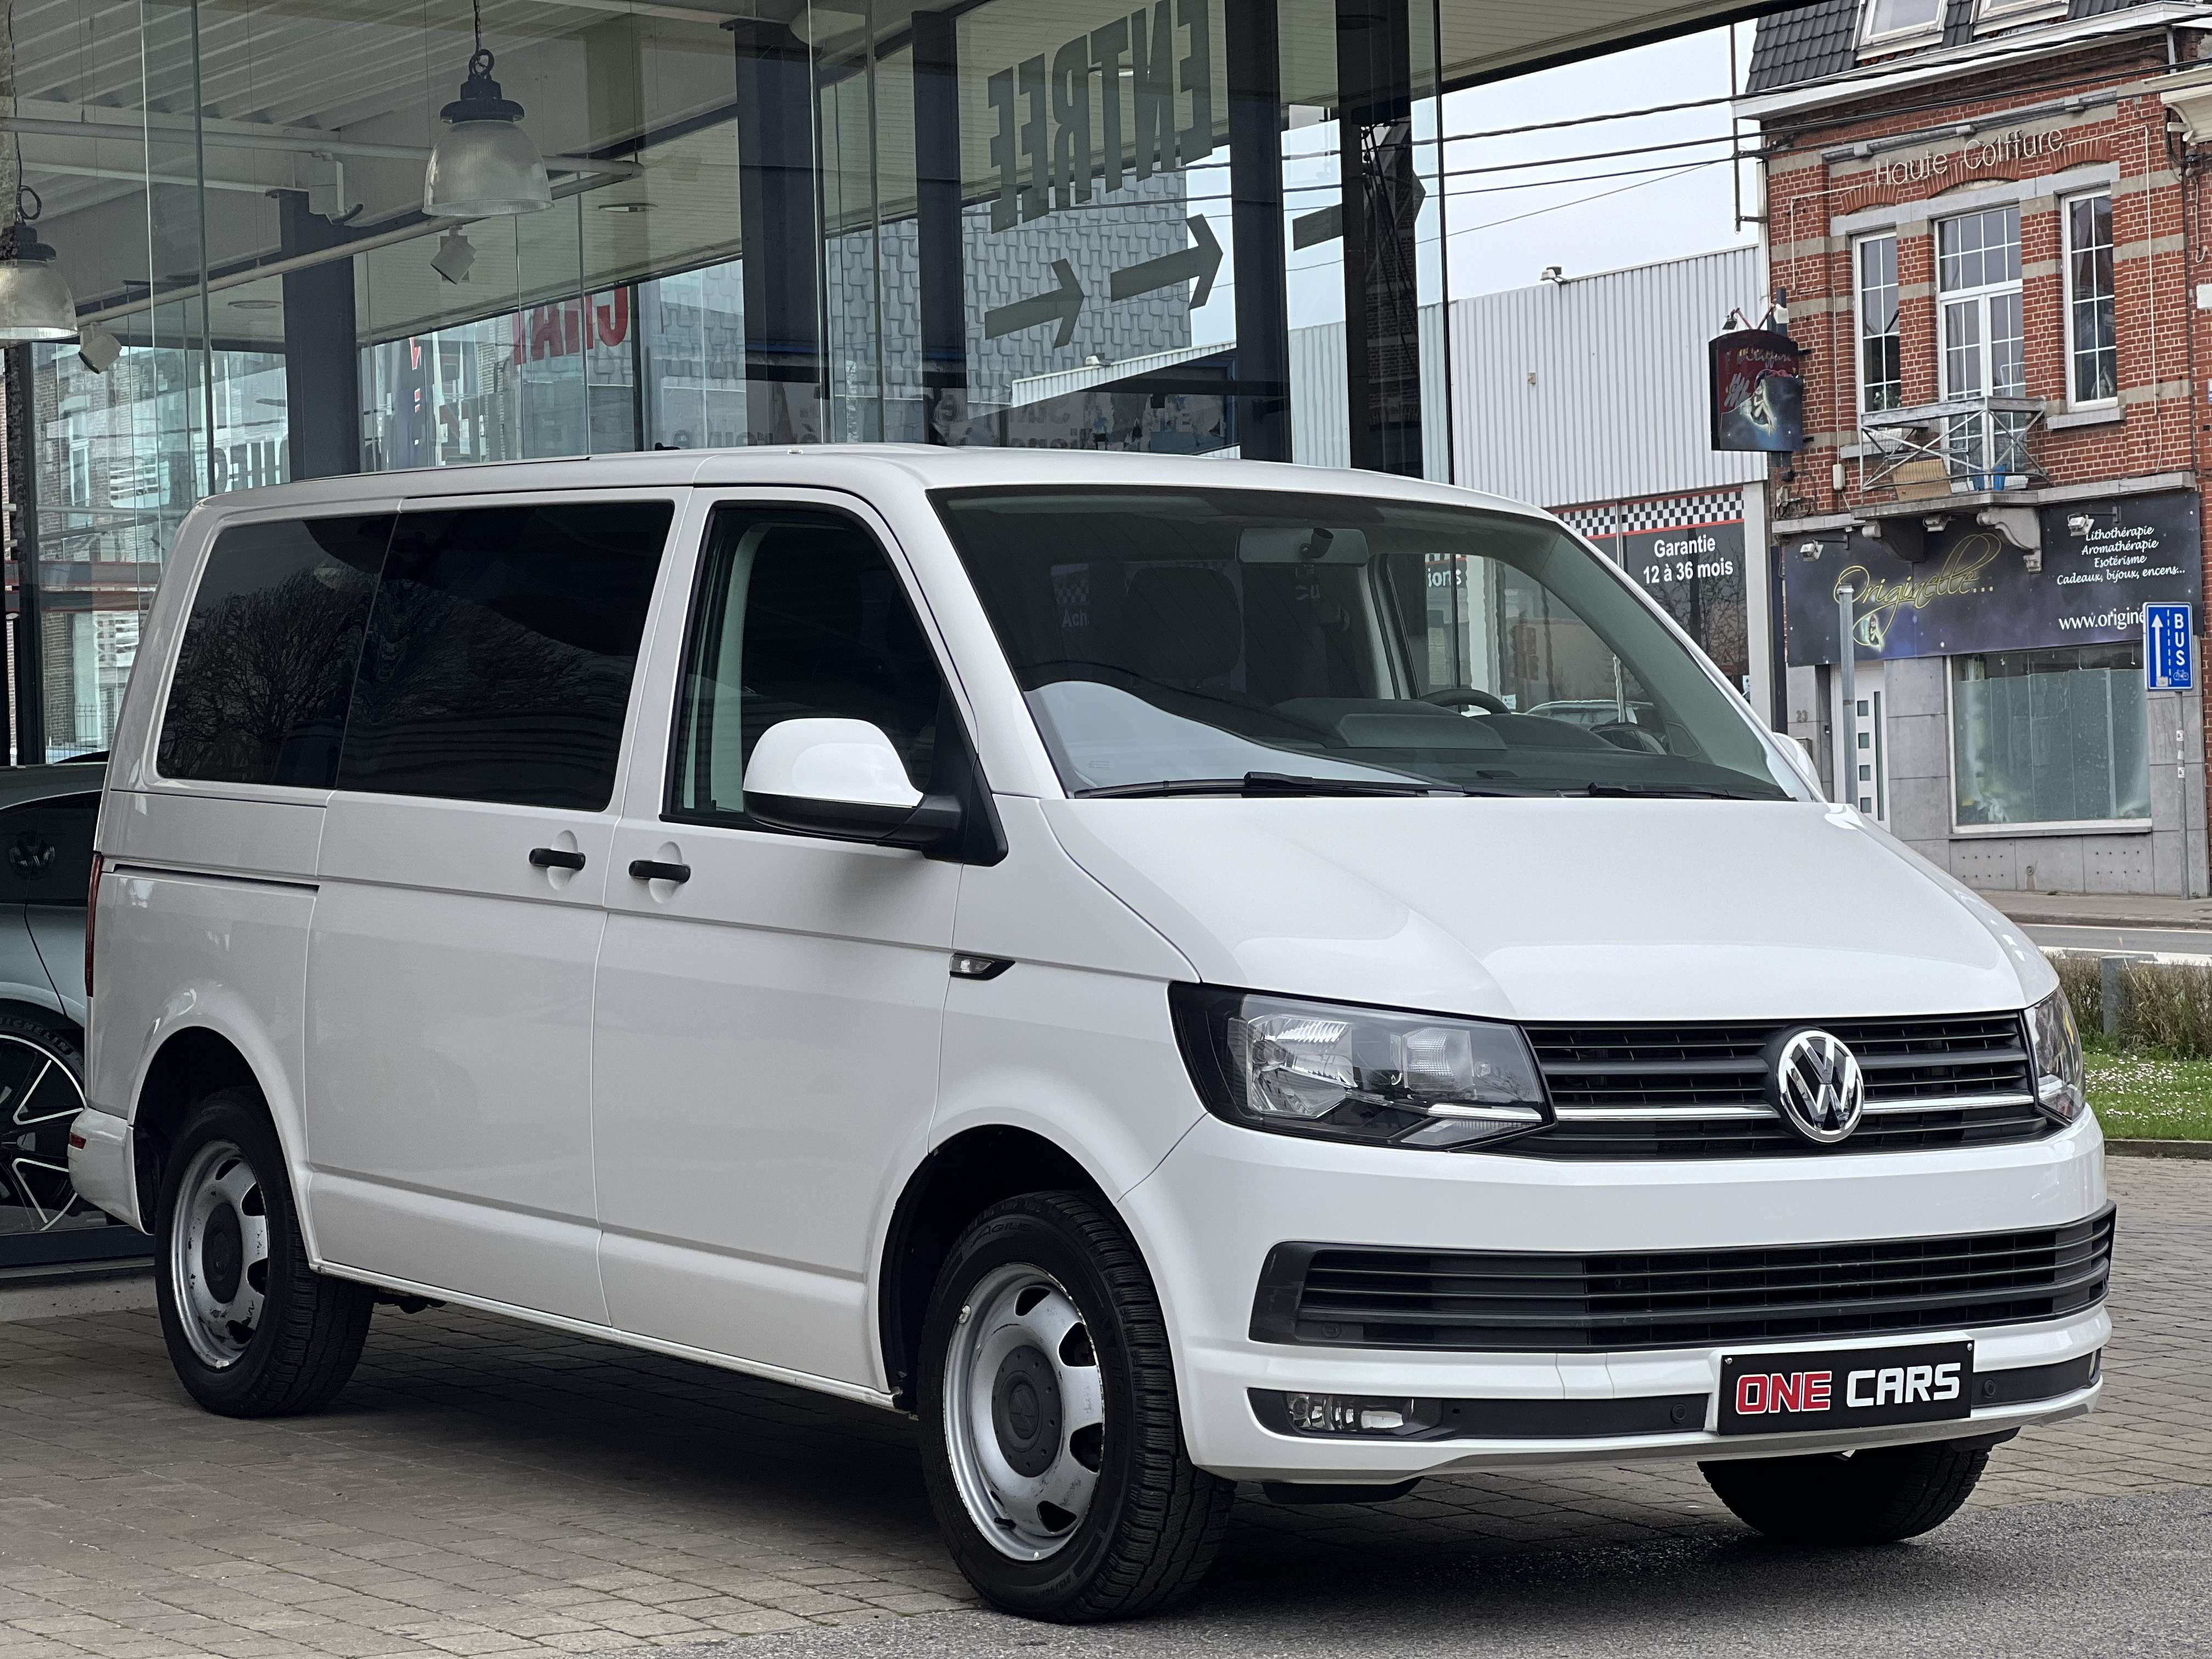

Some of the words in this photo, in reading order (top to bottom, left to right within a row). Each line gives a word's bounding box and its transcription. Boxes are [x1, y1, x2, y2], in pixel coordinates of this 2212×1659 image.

[1876, 150, 1948, 187] Haute
[2085, 525, 2154, 541] Lithothérapie
[1654, 534, 1716, 557] Garantie
[2081, 538, 2159, 555] Aromathérapie
[1643, 565, 1660, 584] 12
[1663, 563, 1672, 582] à
[1676, 561, 1693, 581] 36
[1697, 557, 1733, 578] mois
[2094, 555, 2147, 568] Esotérisme
[2057, 572, 2103, 585] Cadeaux,
[2106, 569, 2140, 583] bijoux,
[2174, 613, 2186, 666] BUS
[1796, 709, 1809, 723] 23
[1736, 1371, 1832, 1415] ONE
[1846, 1362, 1961, 1408] CARS
